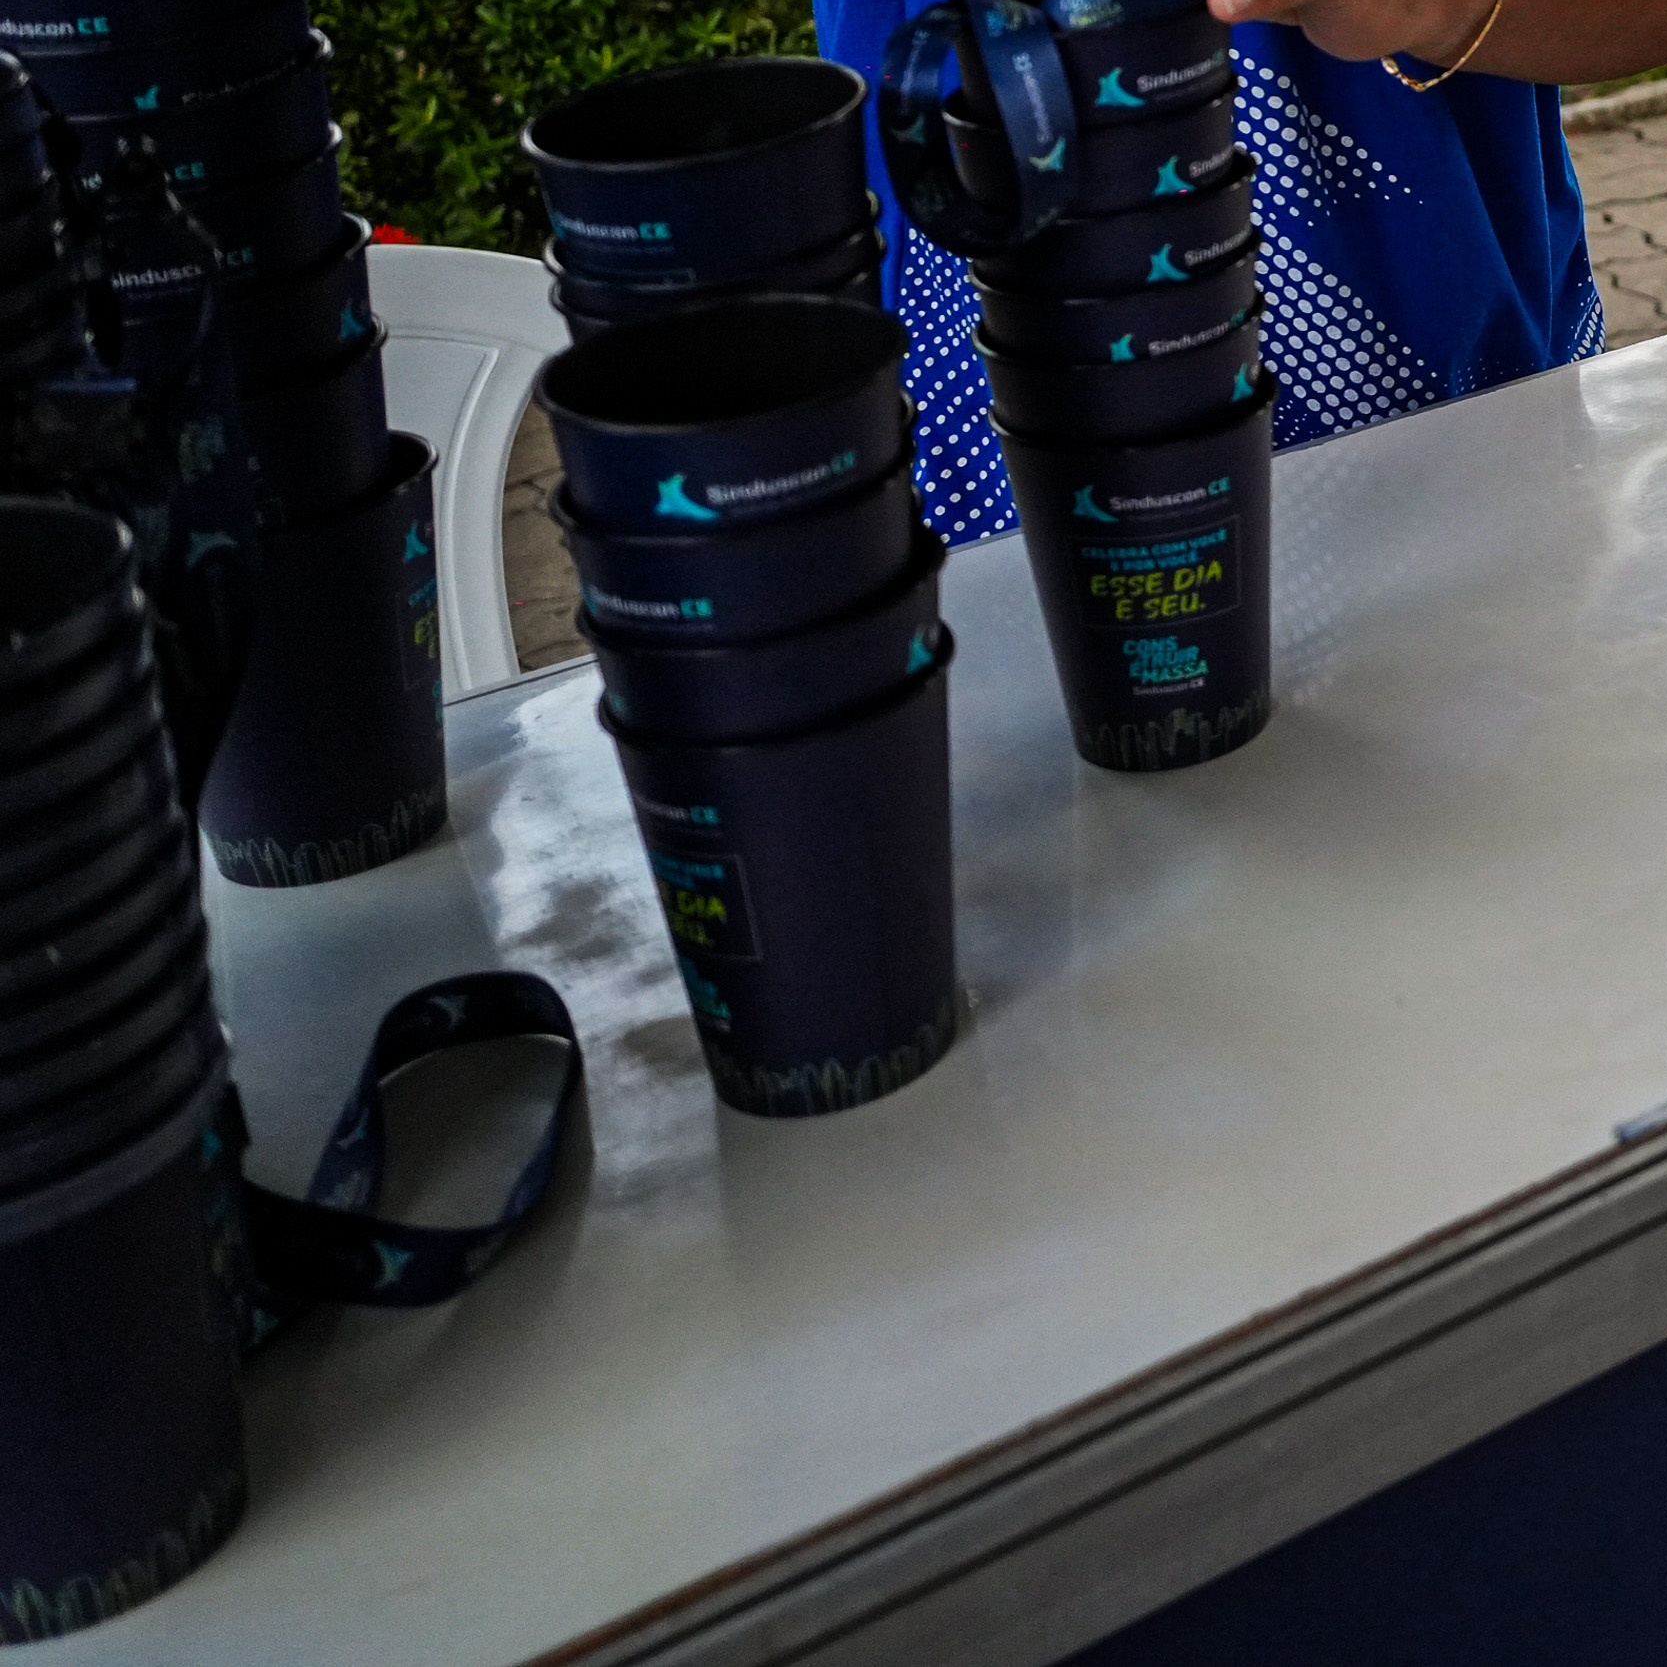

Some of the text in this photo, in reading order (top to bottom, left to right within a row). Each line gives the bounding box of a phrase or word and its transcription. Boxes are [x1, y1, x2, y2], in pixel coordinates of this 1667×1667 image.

[1090, 559, 1224, 596] ESSE DIA
[1142, 592, 1208, 620] SEU.
